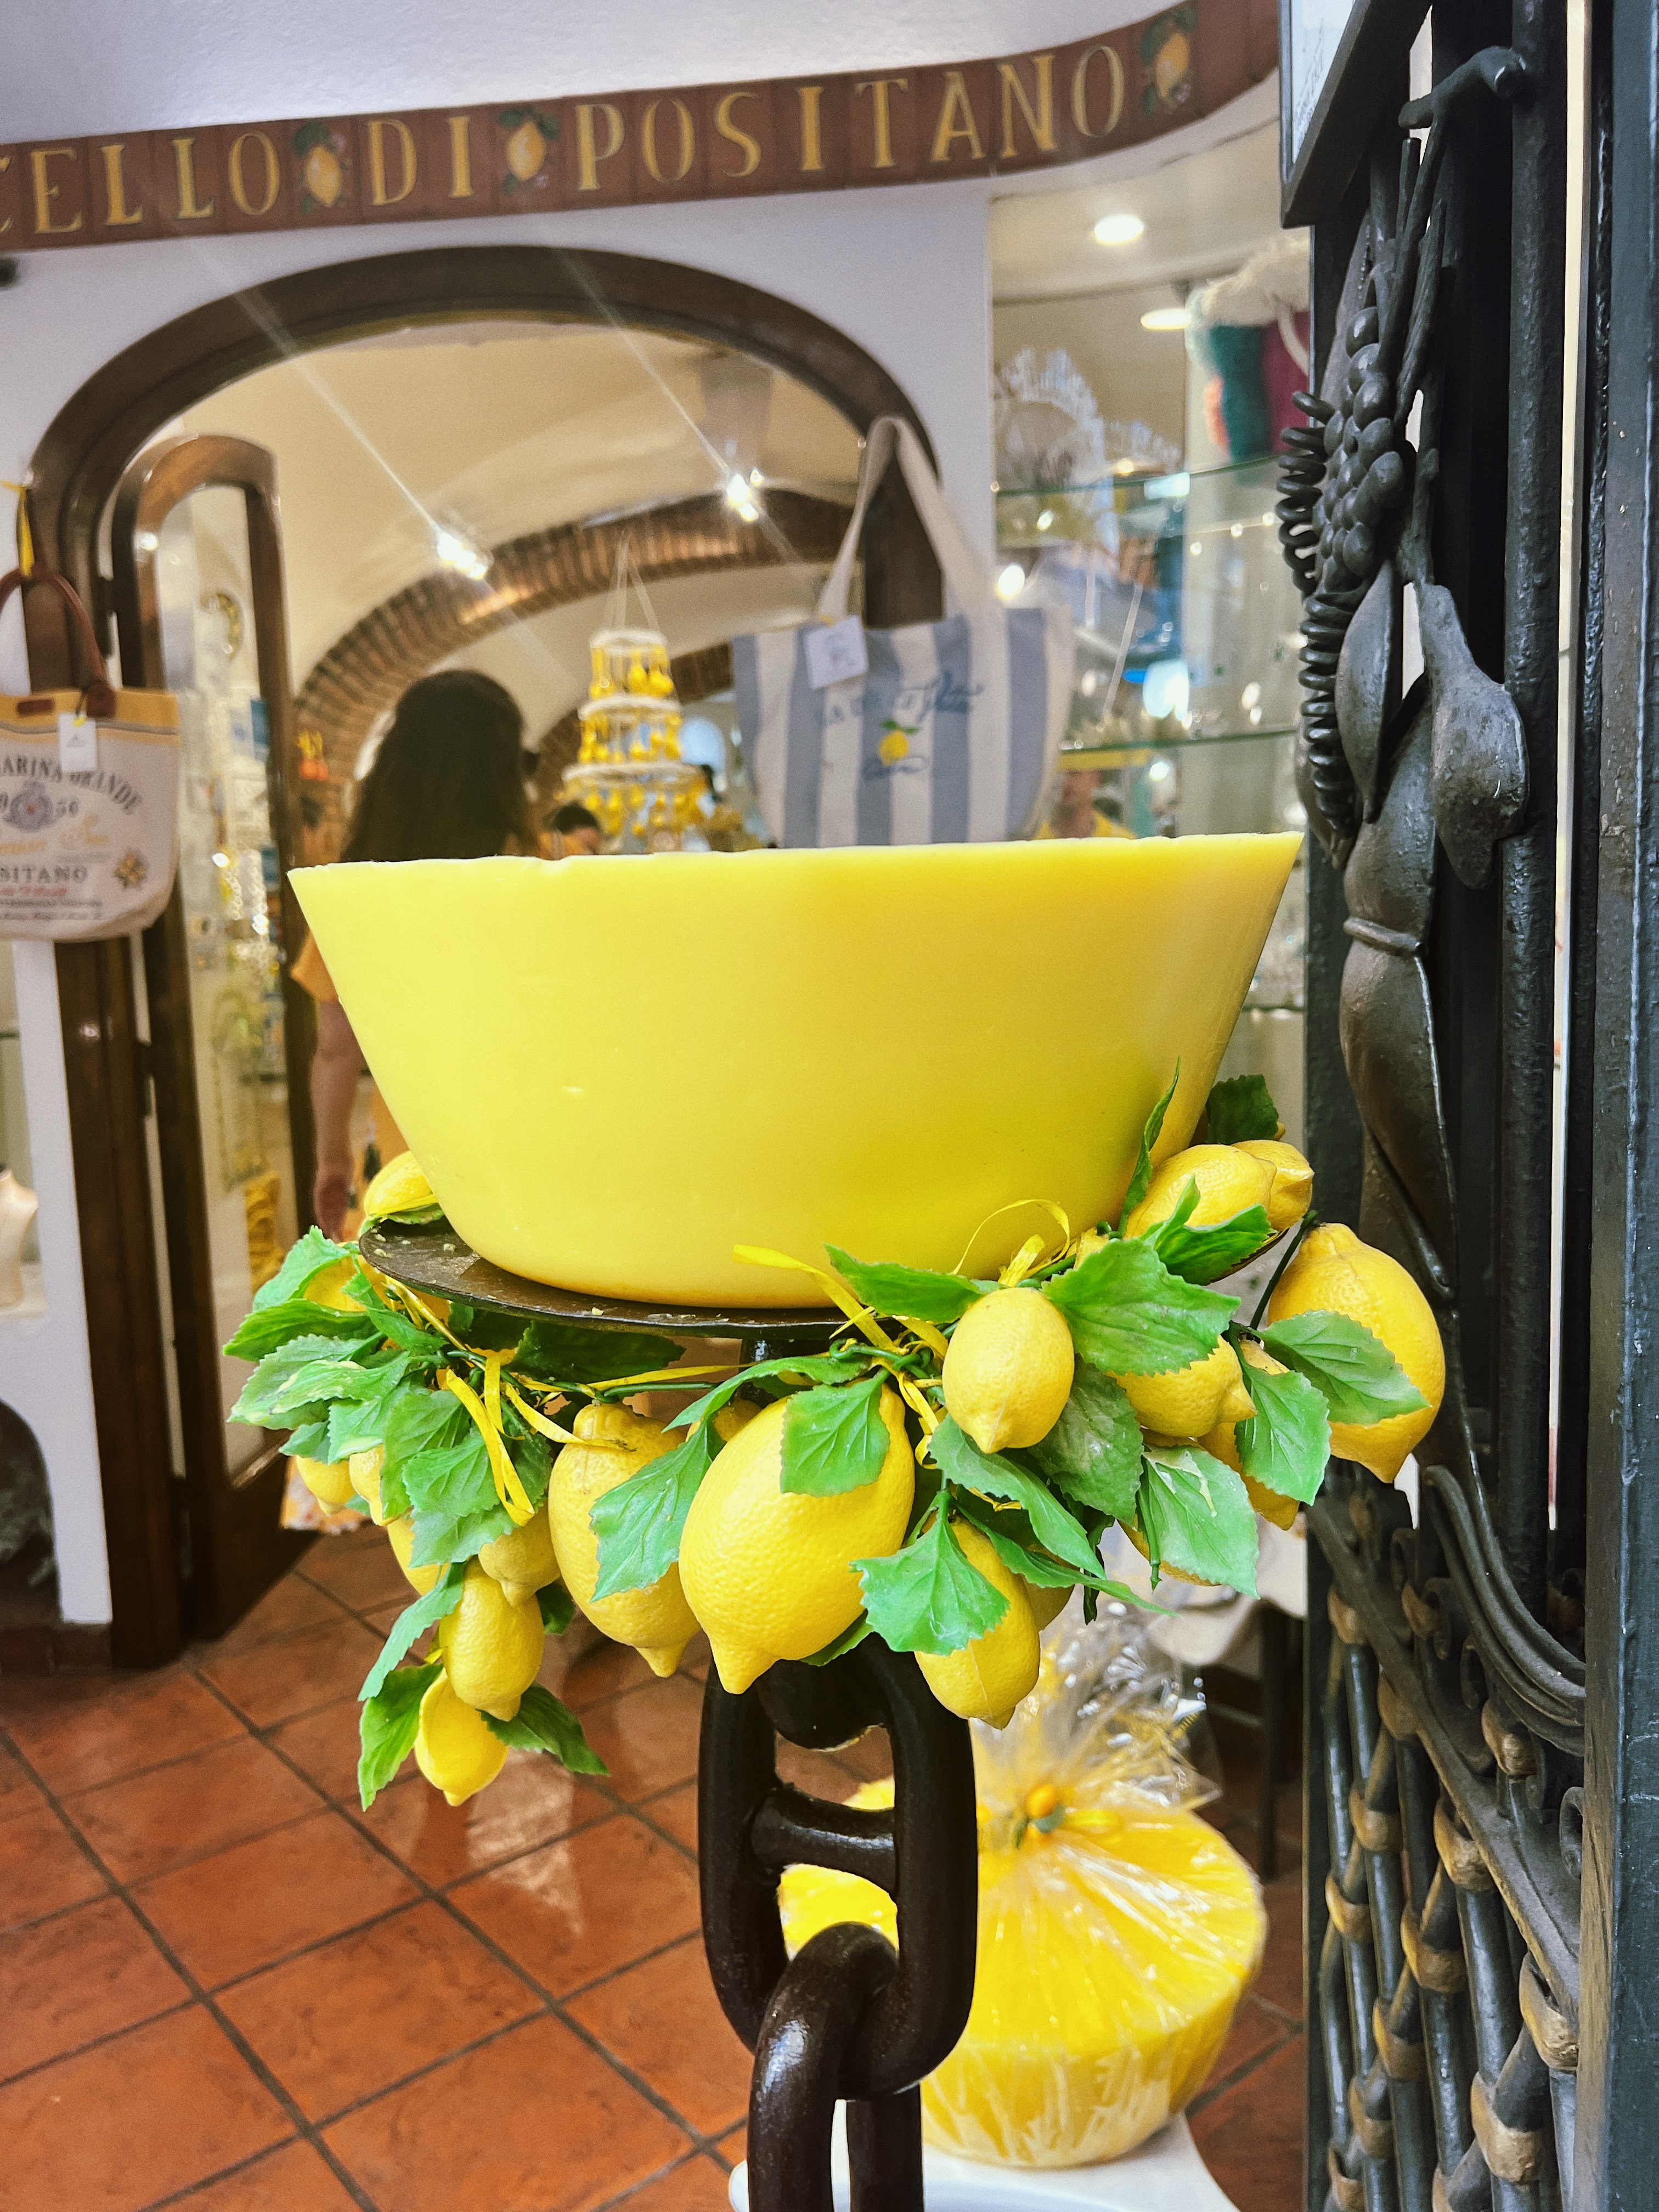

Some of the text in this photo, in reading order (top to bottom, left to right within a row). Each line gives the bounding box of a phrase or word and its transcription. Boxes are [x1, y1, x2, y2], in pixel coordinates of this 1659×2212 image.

[0, 45, 1125, 234] ELLO DI POSITANO
